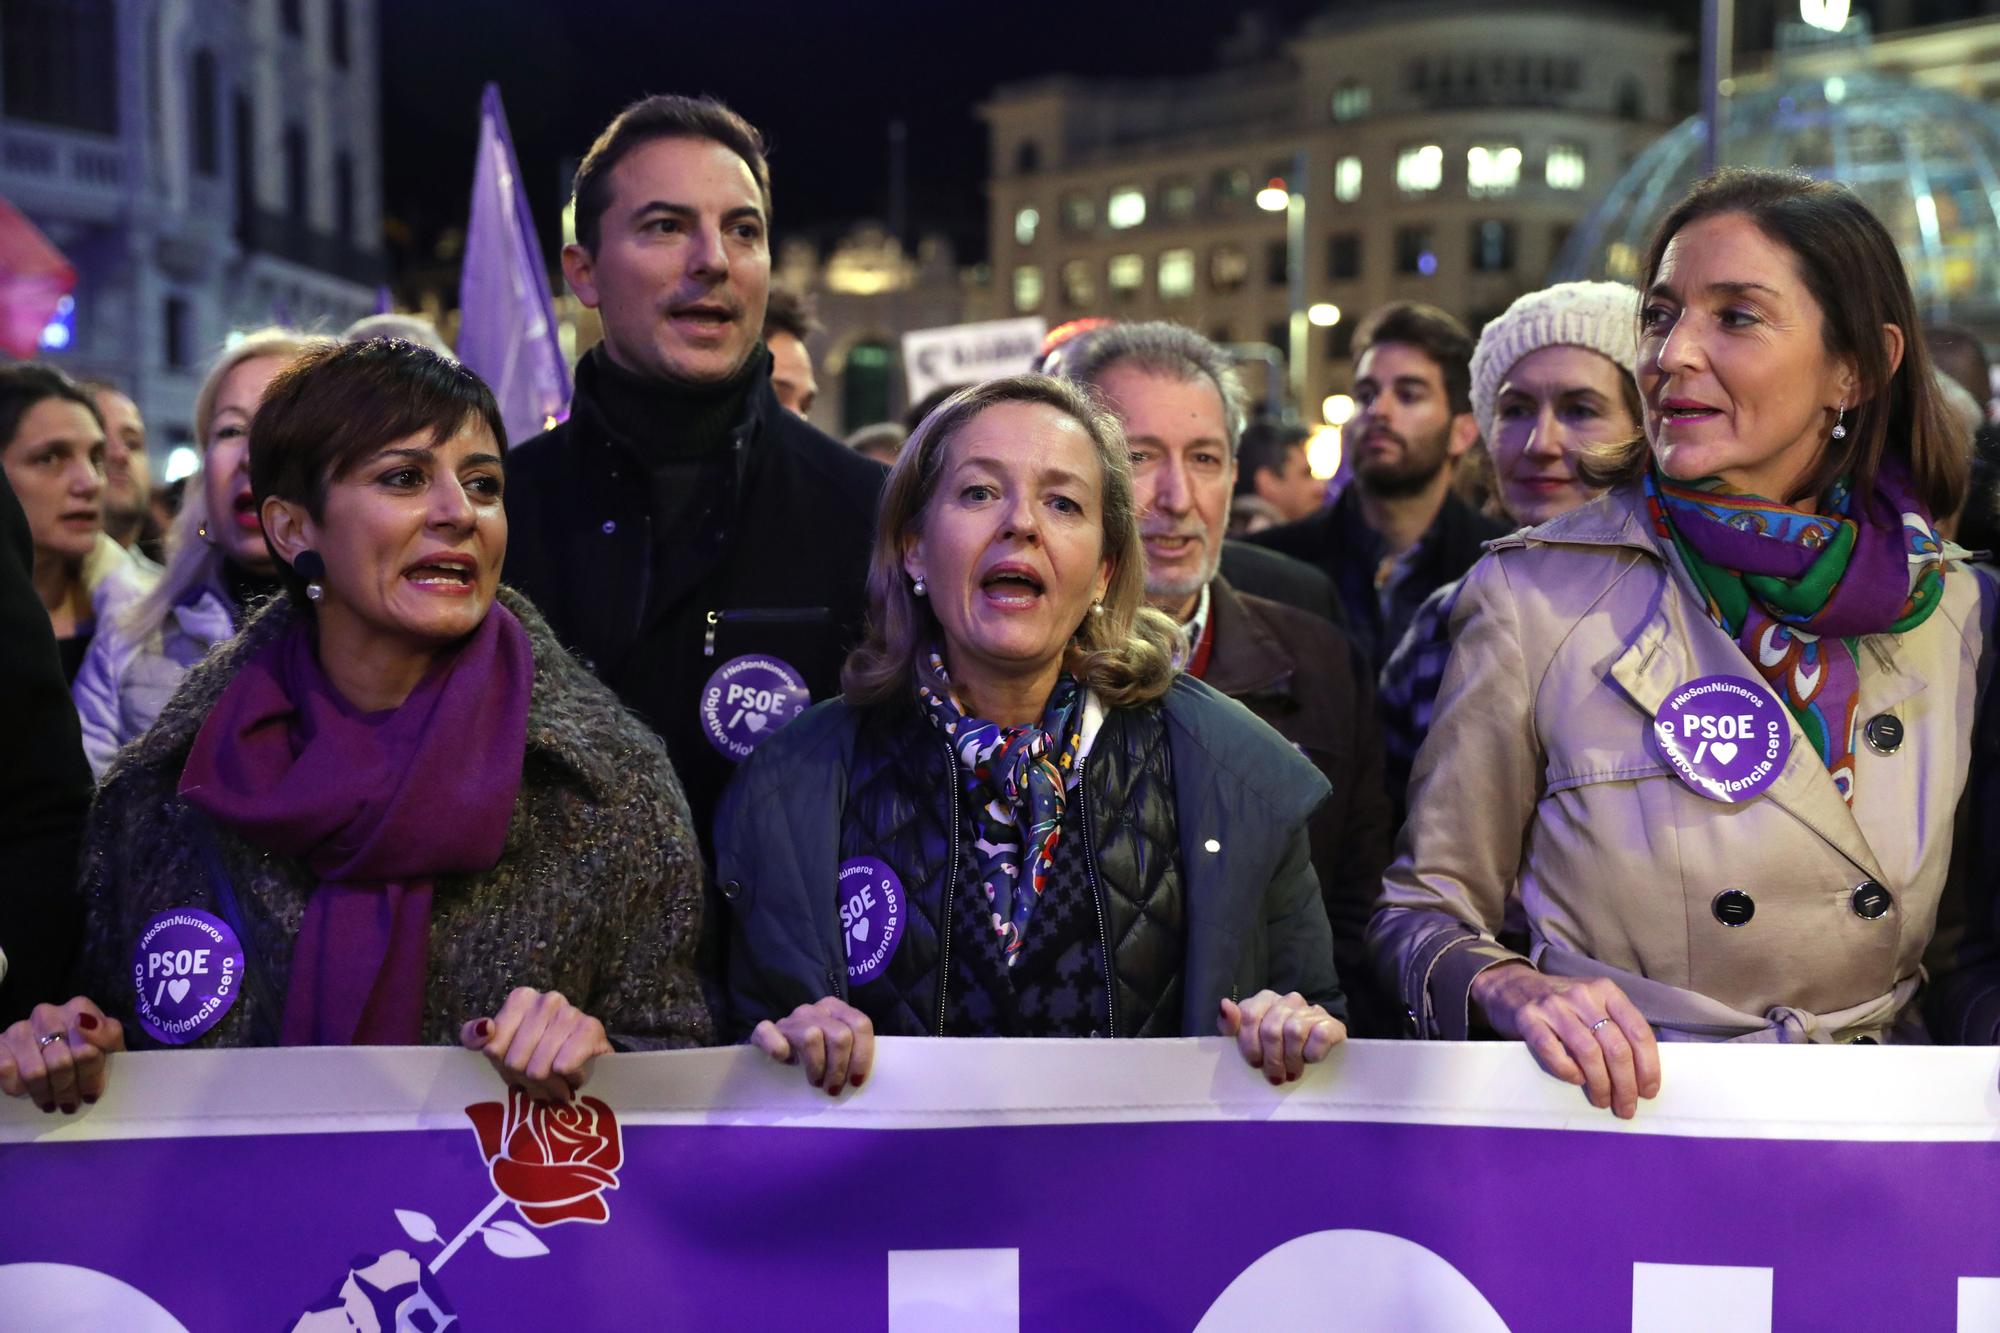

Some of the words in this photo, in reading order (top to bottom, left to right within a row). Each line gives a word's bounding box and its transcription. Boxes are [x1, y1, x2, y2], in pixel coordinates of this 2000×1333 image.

[726, 683, 787, 716] PSOE
[1670, 682, 1764, 711] #NoSonNúmeros
[1683, 714, 1755, 740] PSOE
[1766, 720, 1780, 759] cero
[840, 883, 877, 928] SOE
[141, 915, 223, 950] #NoSonNúmeros
[856, 916, 898, 975] violencia
[881, 879, 898, 914] cero
[149, 949, 211, 978] PSOE
[162, 996, 222, 1034] violencia
[217, 957, 234, 996] cero
